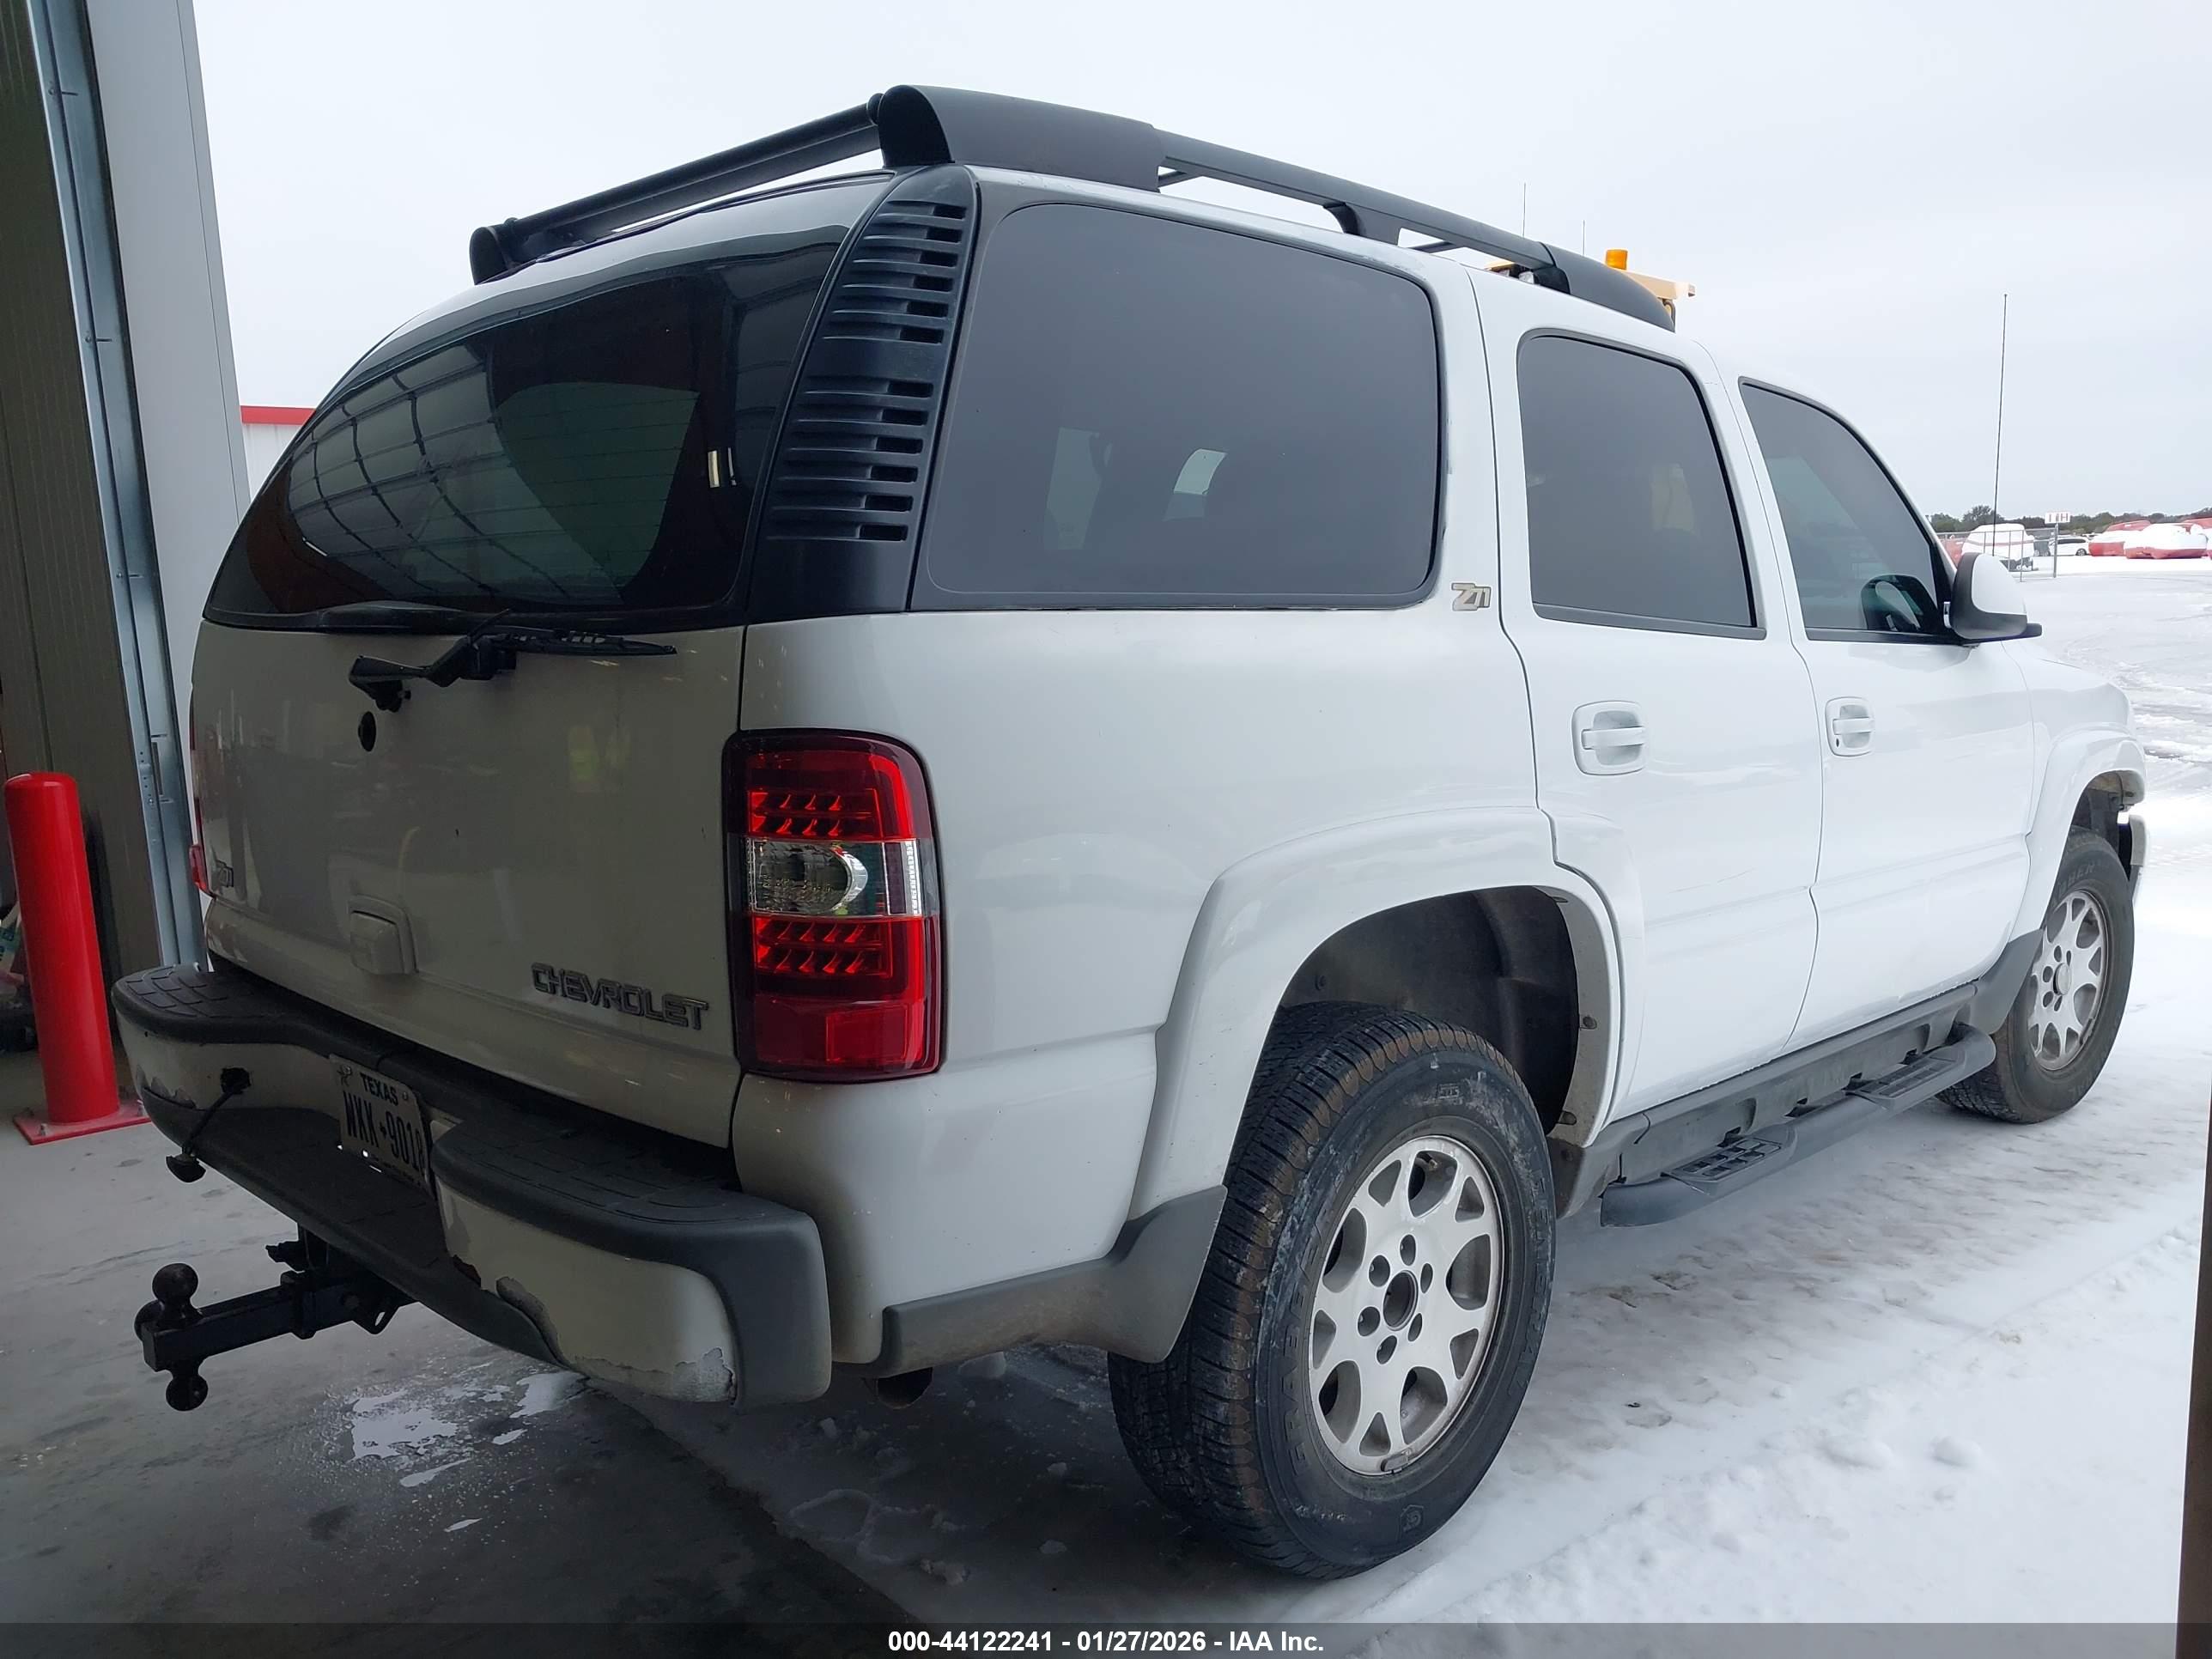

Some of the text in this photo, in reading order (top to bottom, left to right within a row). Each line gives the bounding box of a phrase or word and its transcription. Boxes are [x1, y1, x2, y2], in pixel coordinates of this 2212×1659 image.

[1451, 582, 1491, 611] Z71
[531, 962, 709, 1030] CHEVROLET
[359, 1073, 398, 1106] TEXAS
